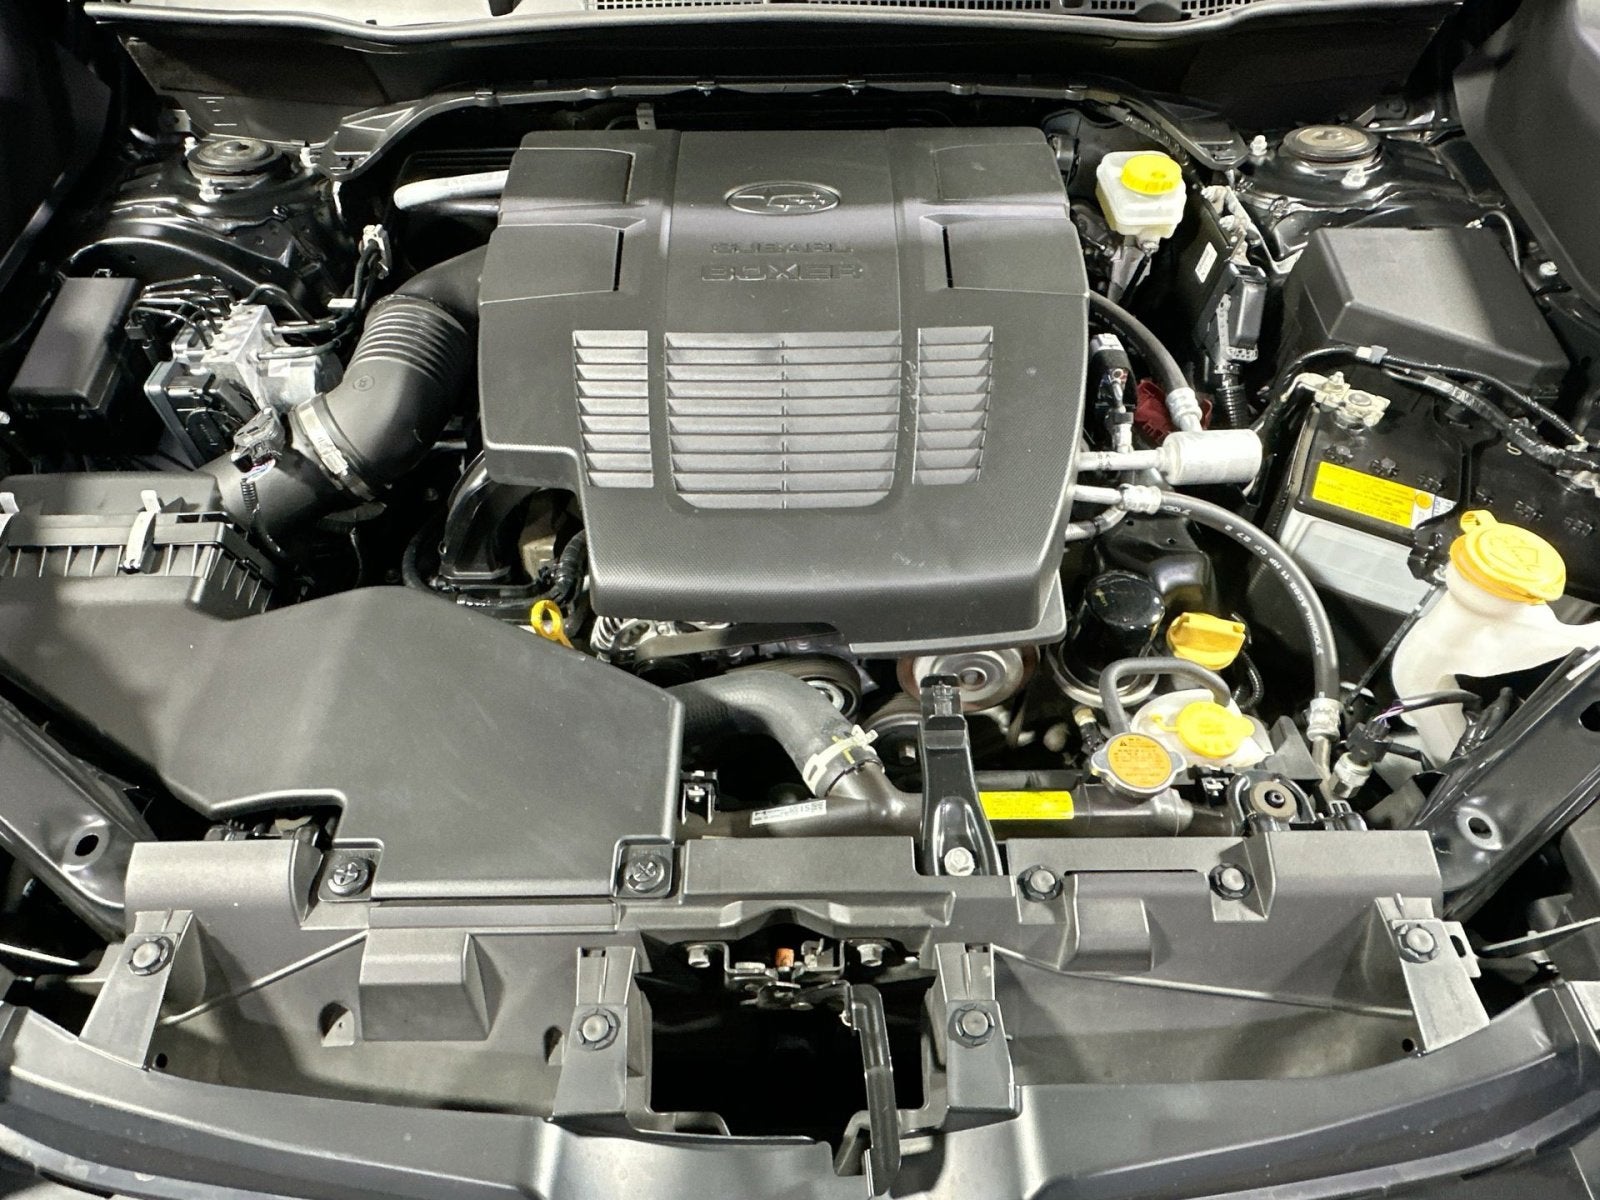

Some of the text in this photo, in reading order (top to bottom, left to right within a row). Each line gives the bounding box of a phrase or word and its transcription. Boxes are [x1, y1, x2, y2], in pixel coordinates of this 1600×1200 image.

[711, 243, 855, 254] SUBARU
[701, 263, 864, 281] BOXER
[1268, 557, 1282, 569] HP
